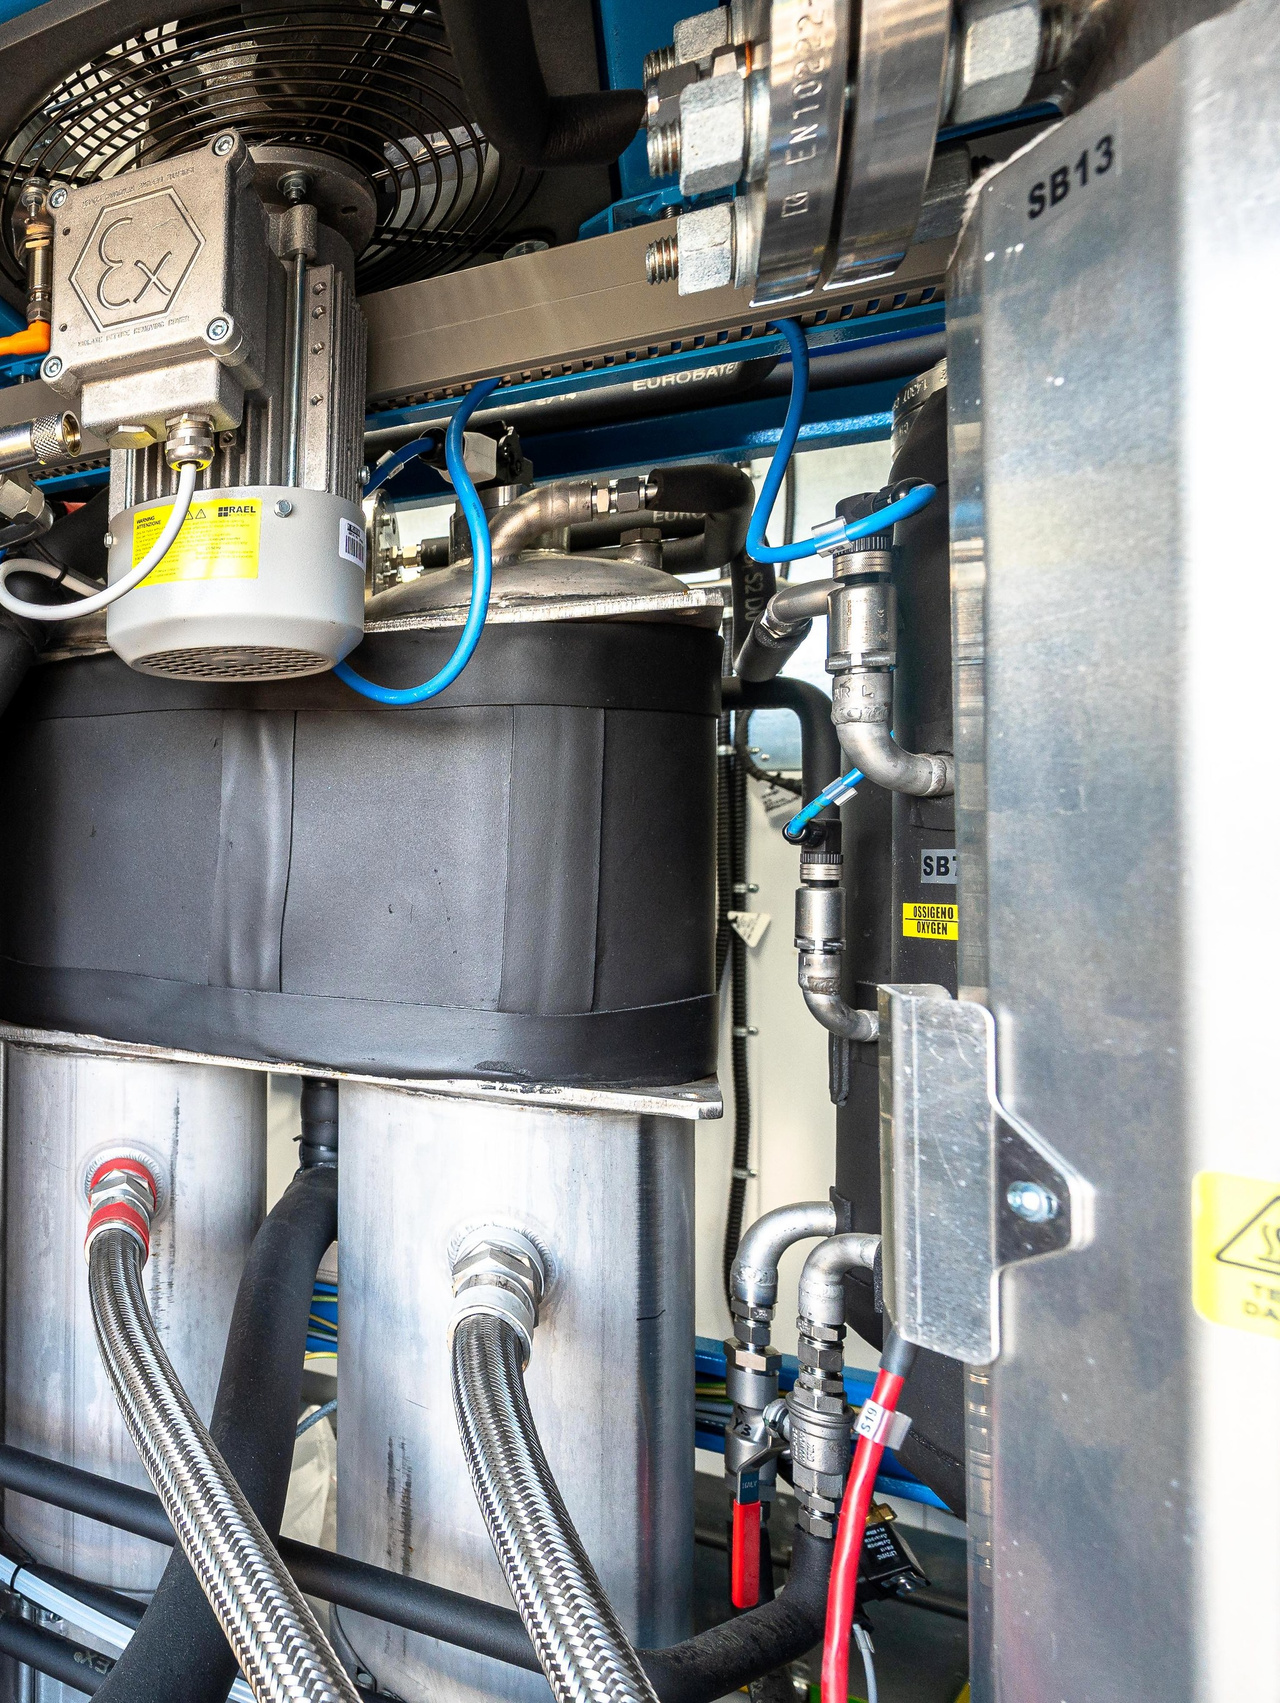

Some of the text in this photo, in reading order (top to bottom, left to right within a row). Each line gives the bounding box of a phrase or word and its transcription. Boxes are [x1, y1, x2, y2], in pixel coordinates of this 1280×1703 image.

[1027, 134, 1115, 220] SB13
[228, 505, 257, 514] RAEL
[913, 905, 954, 920] OSSIGENO
[916, 921, 948, 936] OXYGEN
[860, 1406, 877, 1433] S19
